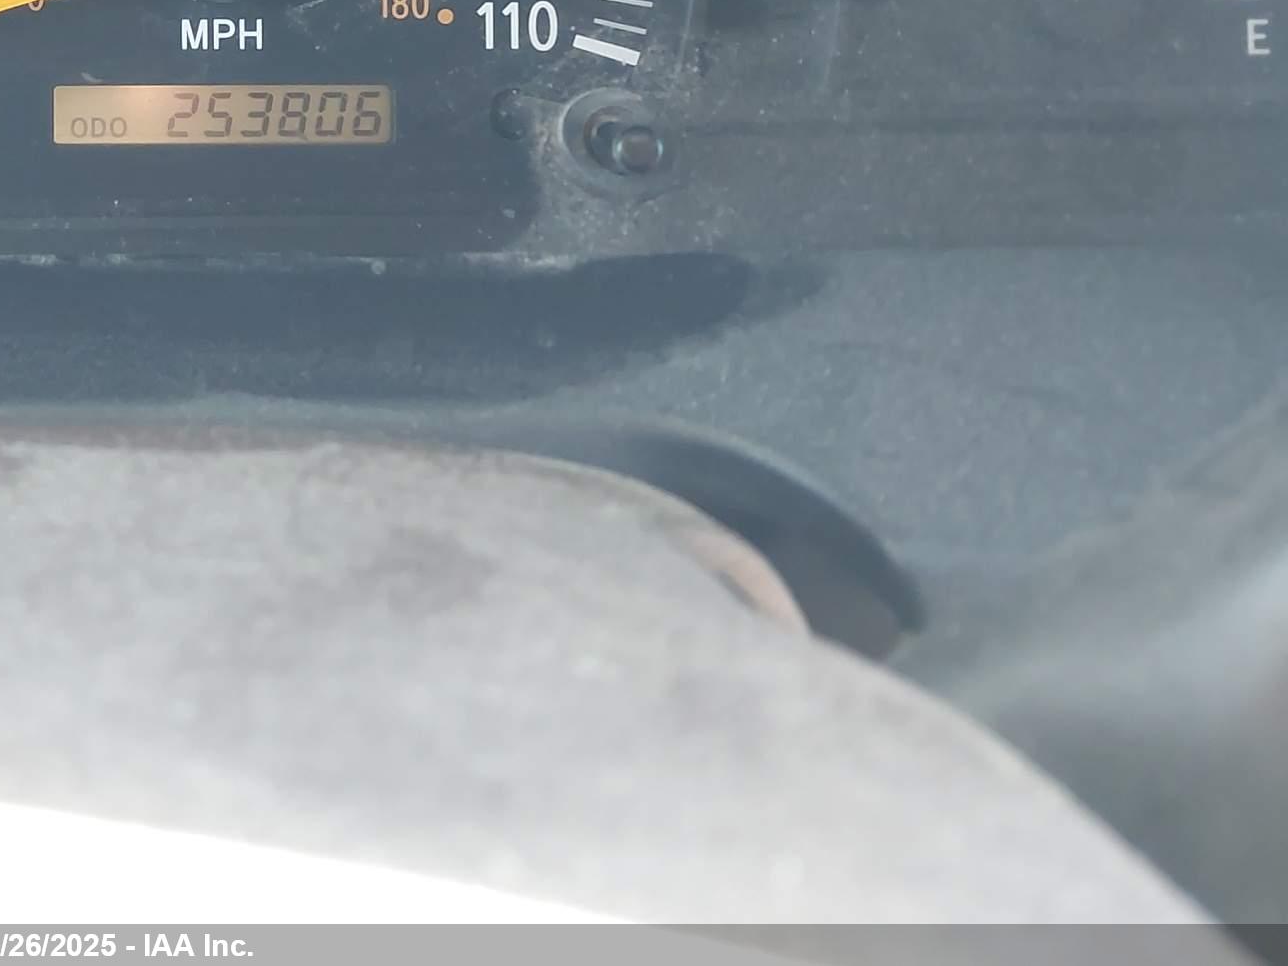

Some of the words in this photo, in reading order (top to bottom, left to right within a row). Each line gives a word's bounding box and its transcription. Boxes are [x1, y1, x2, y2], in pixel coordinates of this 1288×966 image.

[182, 19, 262, 50] MPH
[477, 1, 557, 51] 110
[1247, 19, 1270, 55] E
[70, 117, 127, 138] ODO
[168, 92, 381, 137] 253806
